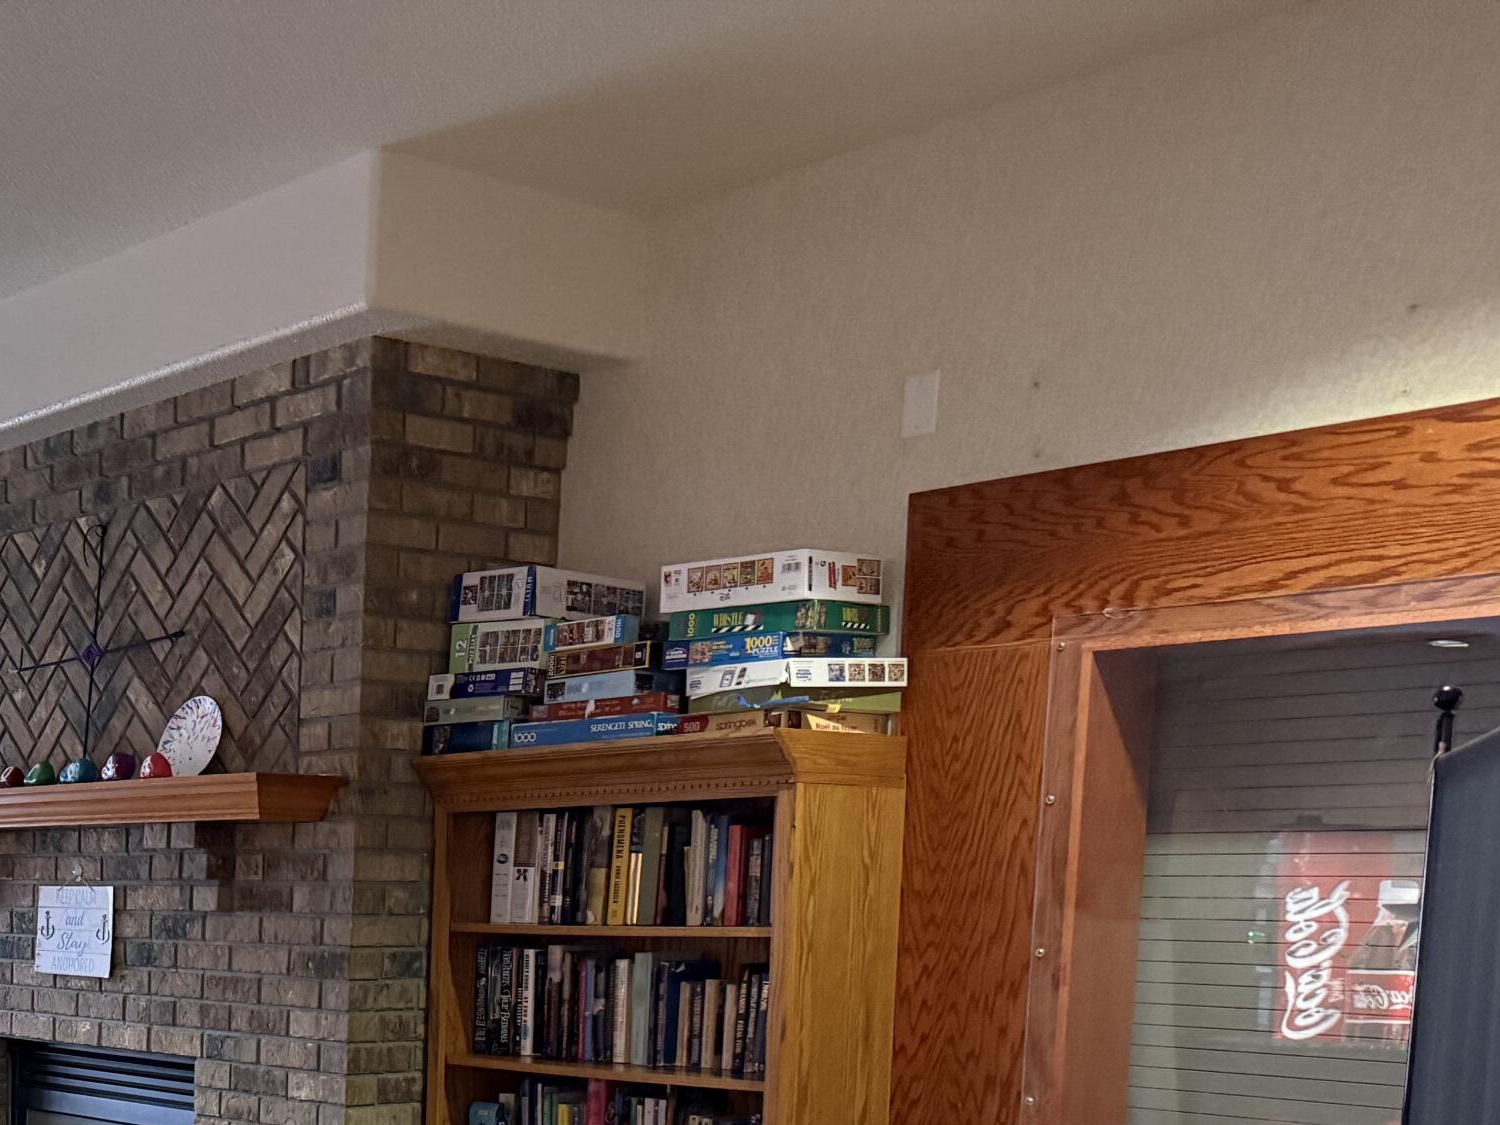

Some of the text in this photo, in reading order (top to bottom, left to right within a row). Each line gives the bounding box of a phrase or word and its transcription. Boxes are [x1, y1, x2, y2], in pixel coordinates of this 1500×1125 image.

[455, 640, 467, 658] 12
[744, 636, 773, 655] 1000
[65, 912, 84, 926] and
[56, 932, 88, 957] Stay
[51, 957, 95, 973] ANCHORED
